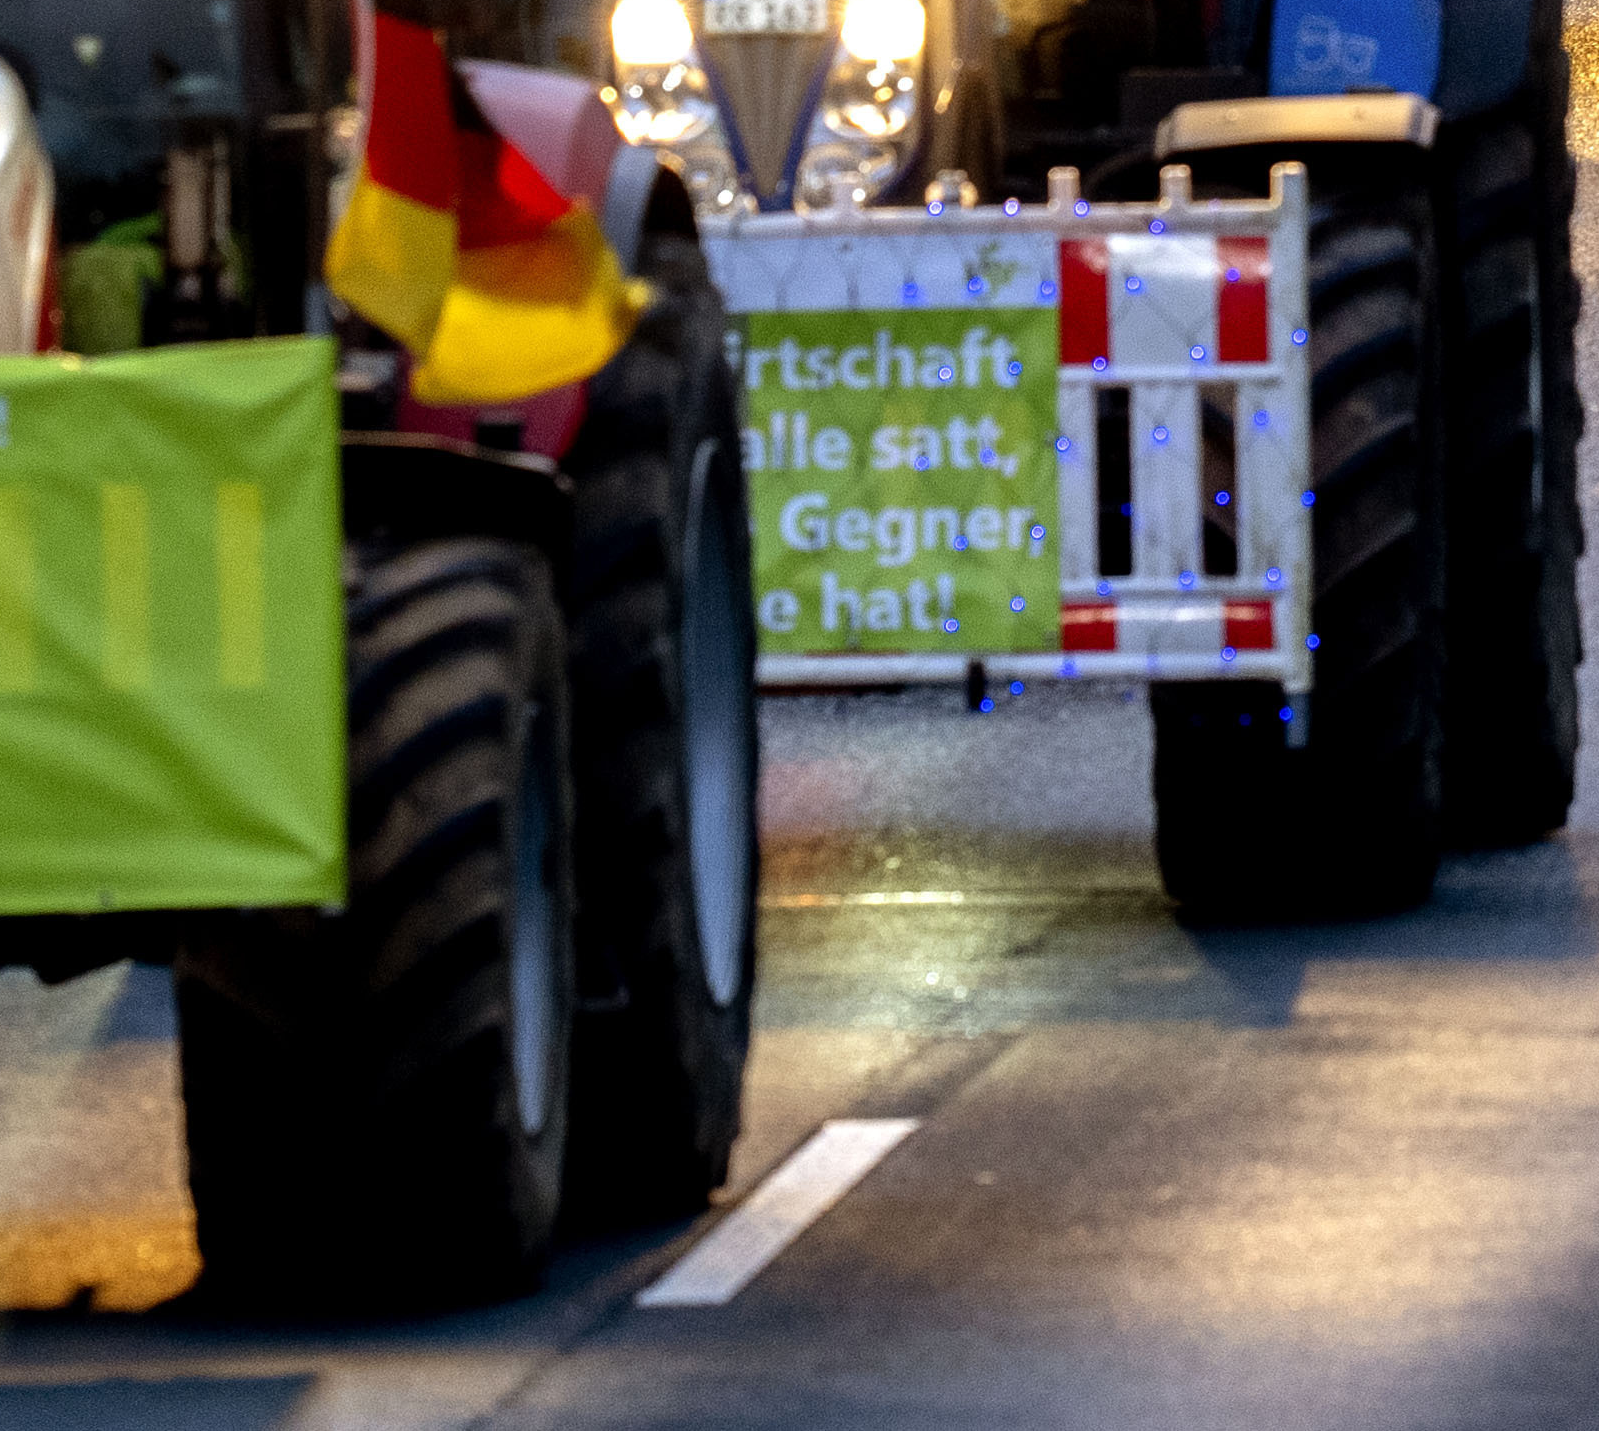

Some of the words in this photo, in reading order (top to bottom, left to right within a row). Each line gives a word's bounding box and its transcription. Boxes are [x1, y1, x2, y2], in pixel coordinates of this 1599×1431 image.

[872, 416, 1020, 478] satt,
[778, 492, 1045, 568] Gegner,
[820, 570, 958, 633] hat!
